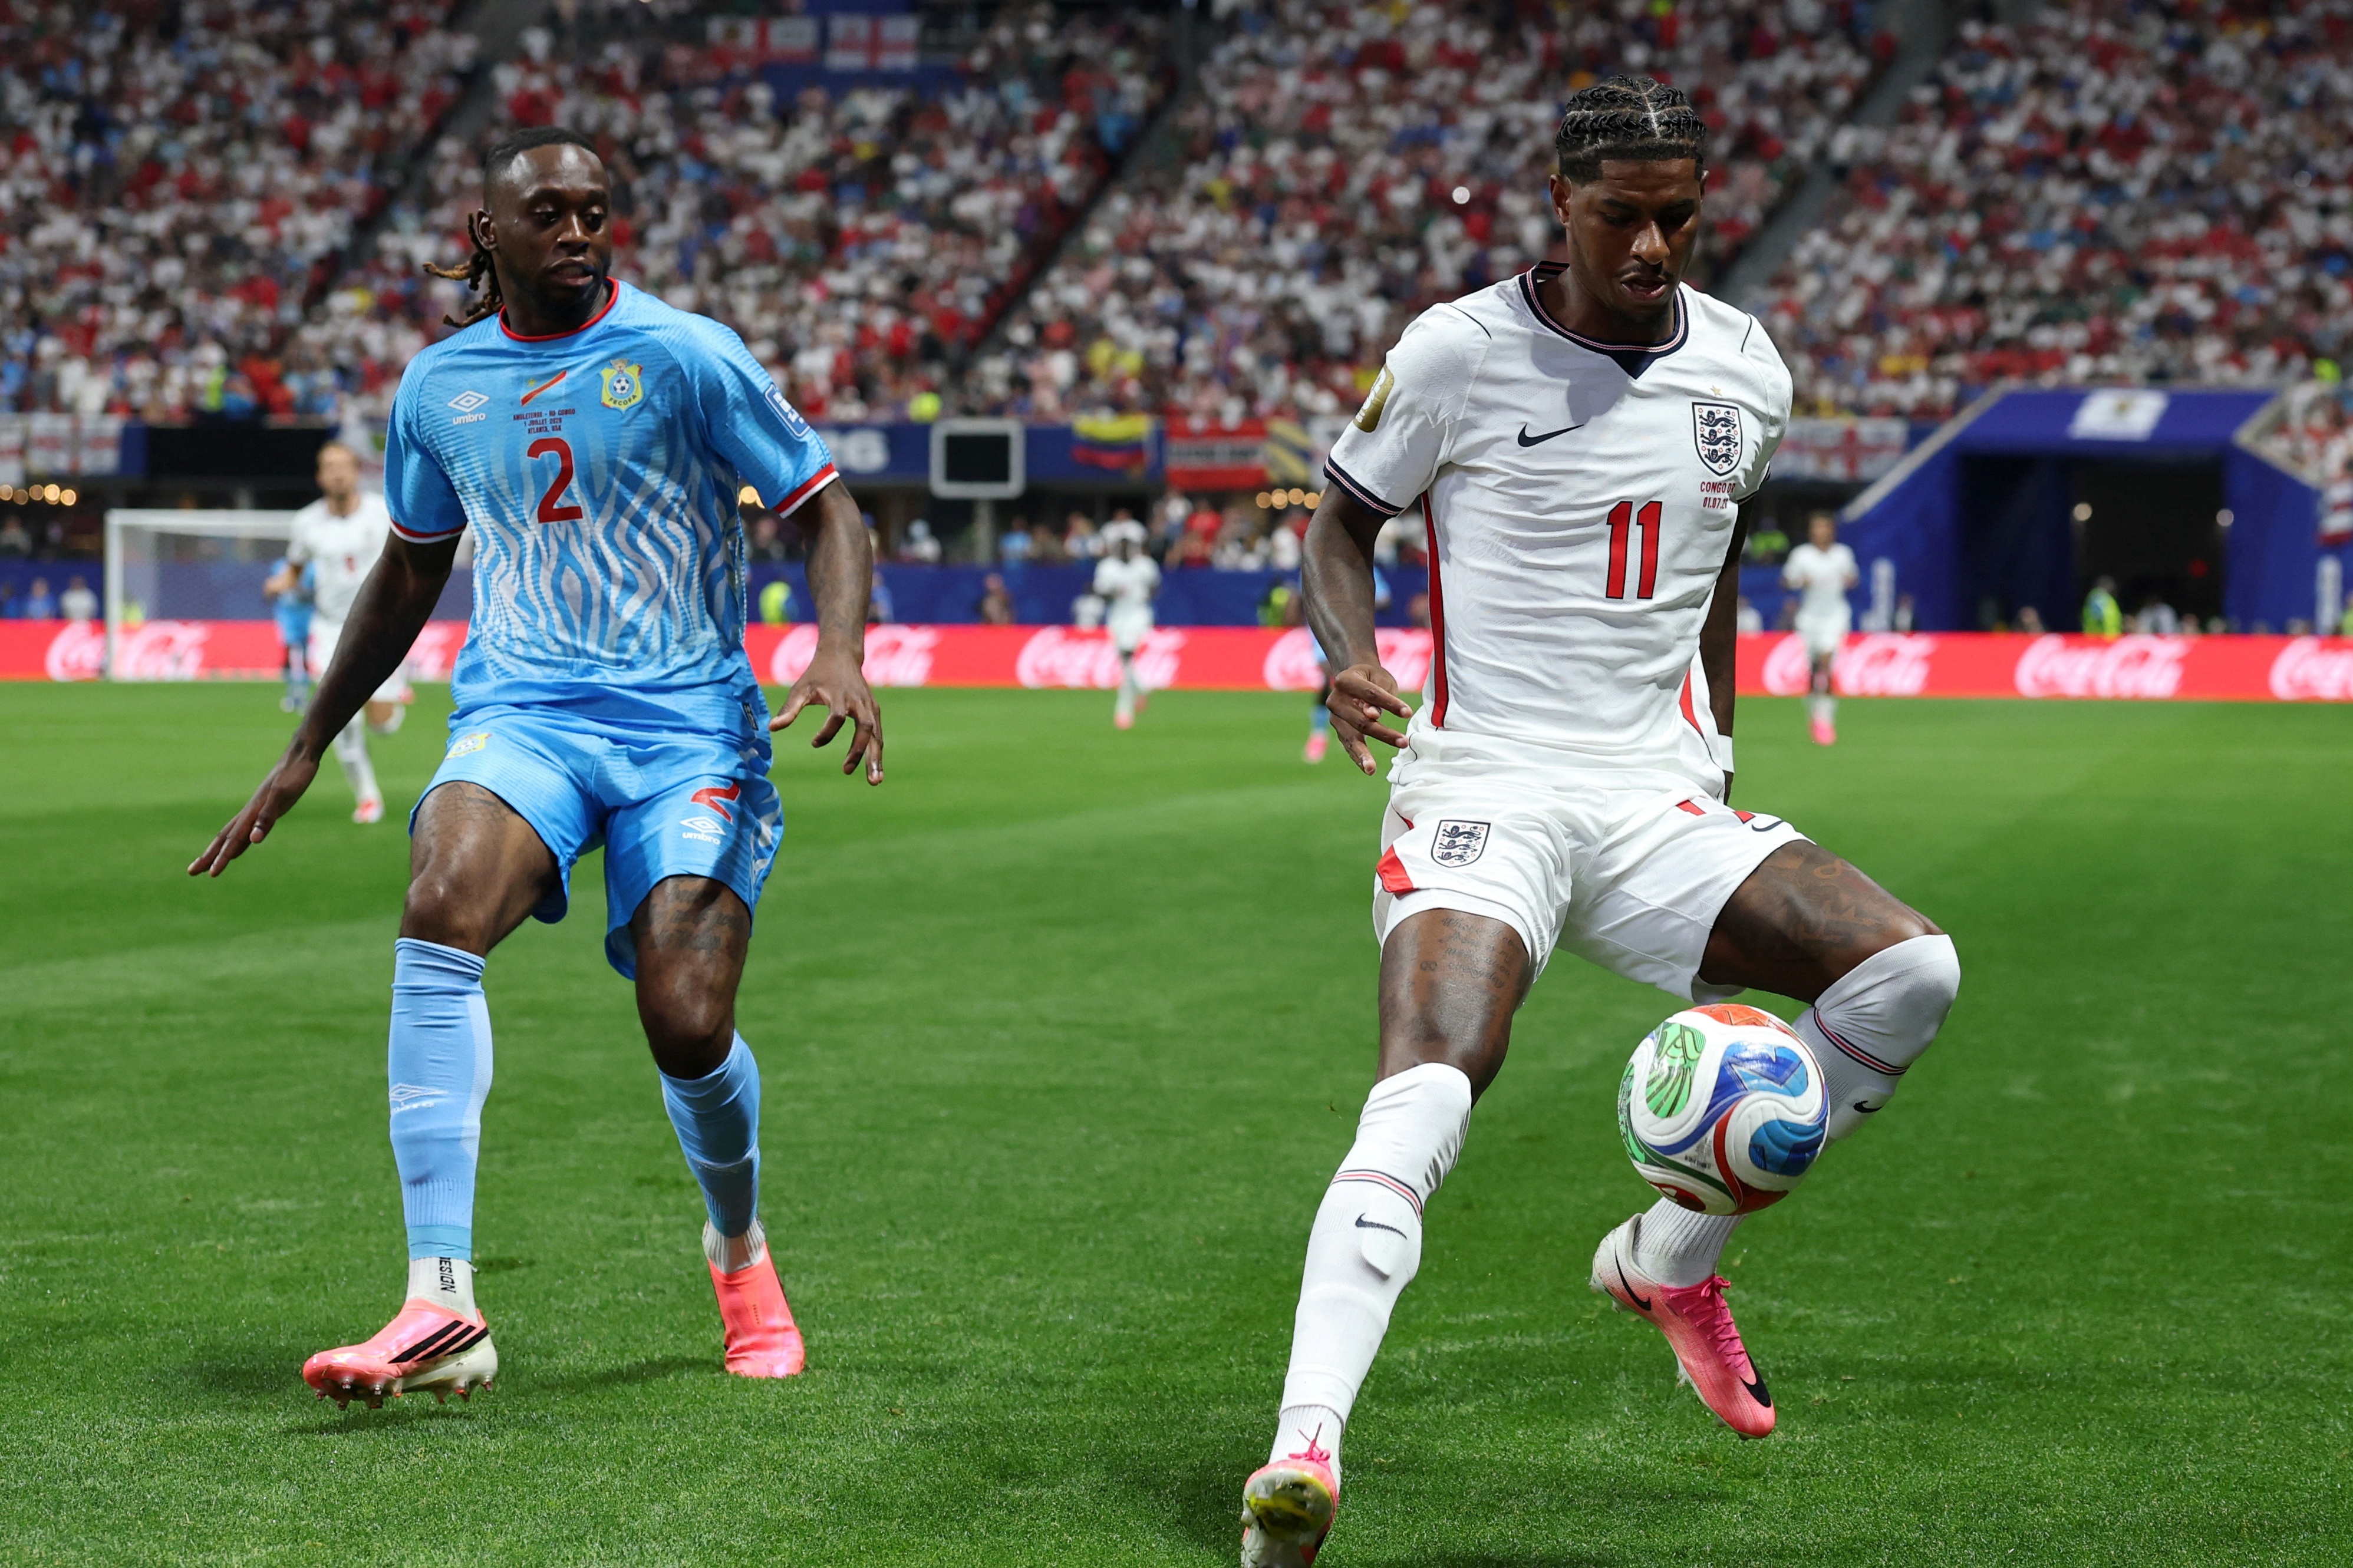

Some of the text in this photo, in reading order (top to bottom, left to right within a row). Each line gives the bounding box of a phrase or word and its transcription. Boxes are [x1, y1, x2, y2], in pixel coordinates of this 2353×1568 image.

[452, 412, 486, 425] umbro
[527, 437, 583, 524] 2
[1700, 481, 1726, 493] CONGO
[1606, 501, 1663, 600] 11
[682, 831, 721, 845] umbro
